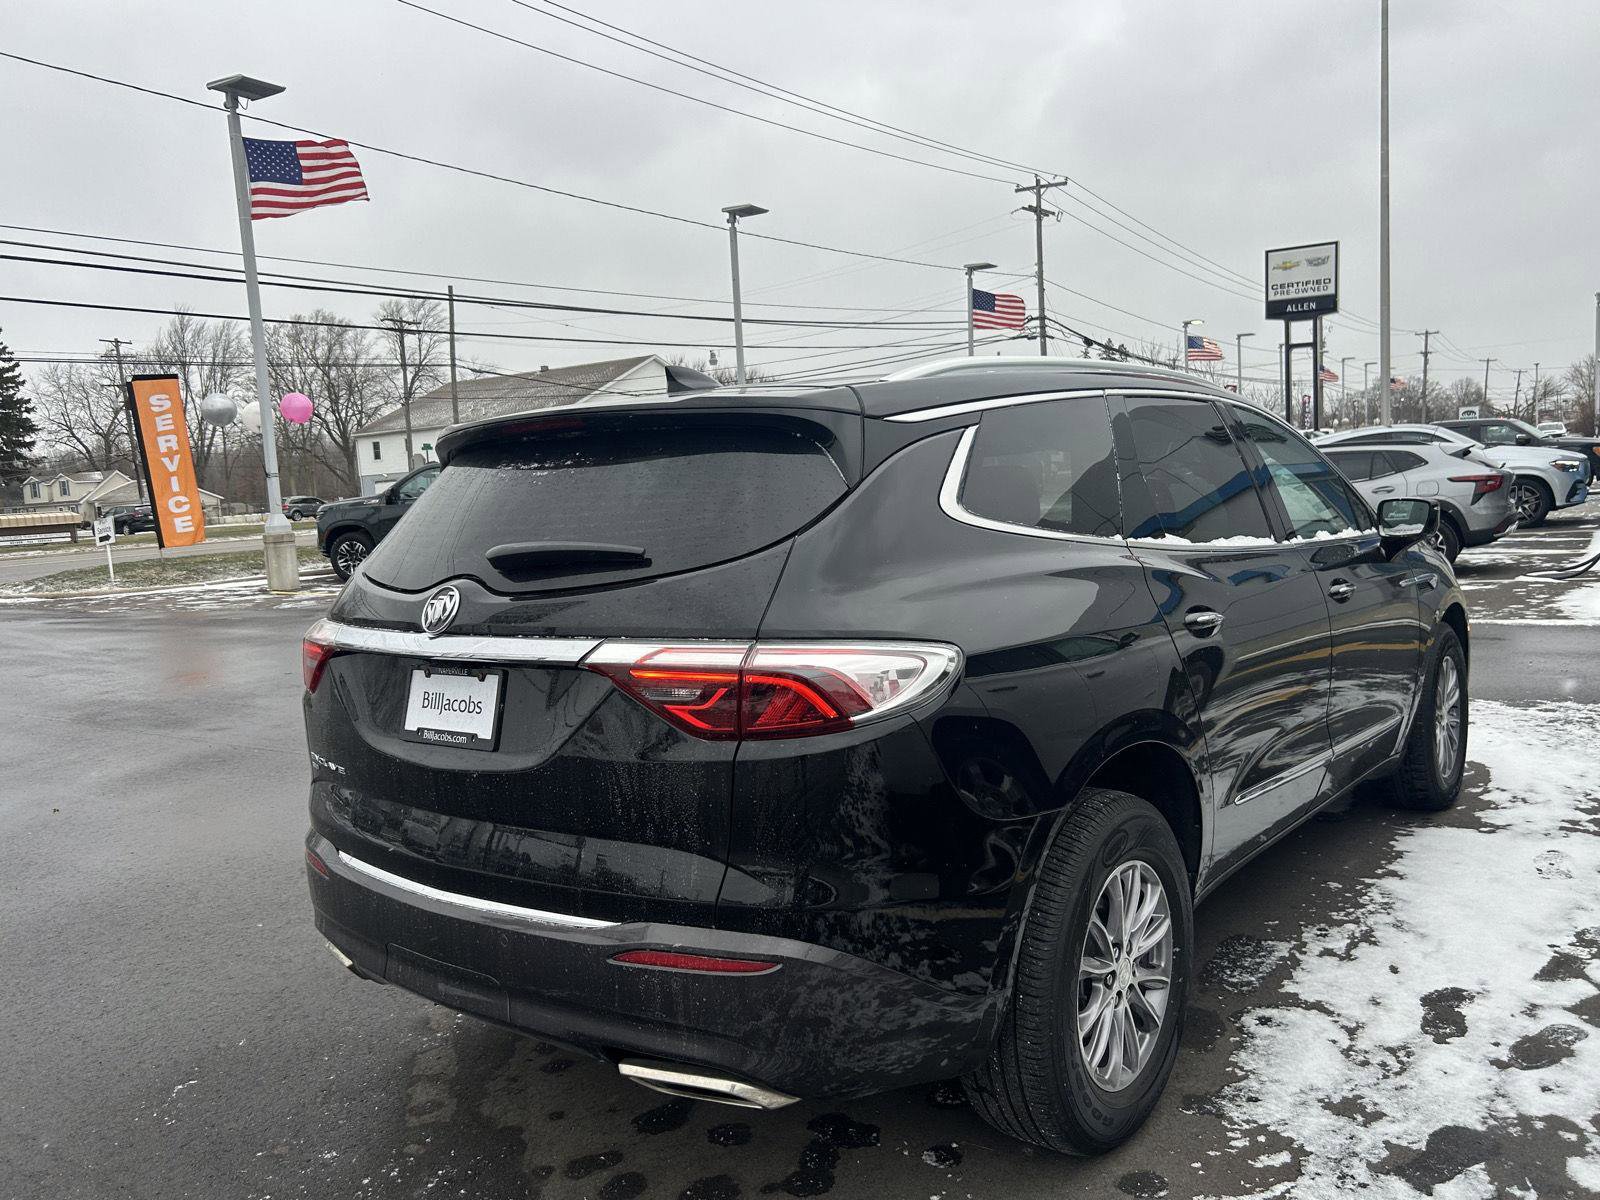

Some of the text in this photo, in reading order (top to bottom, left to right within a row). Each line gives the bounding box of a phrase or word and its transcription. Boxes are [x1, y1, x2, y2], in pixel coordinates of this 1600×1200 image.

[1271, 278, 1332, 291] CERTIFIED
[1273, 285, 1329, 297] PRE-OWNED
[1286, 302, 1316, 313] ALLEN
[149, 394, 195, 533] SERVICE
[423, 730, 467, 744] BillJacobs.com
